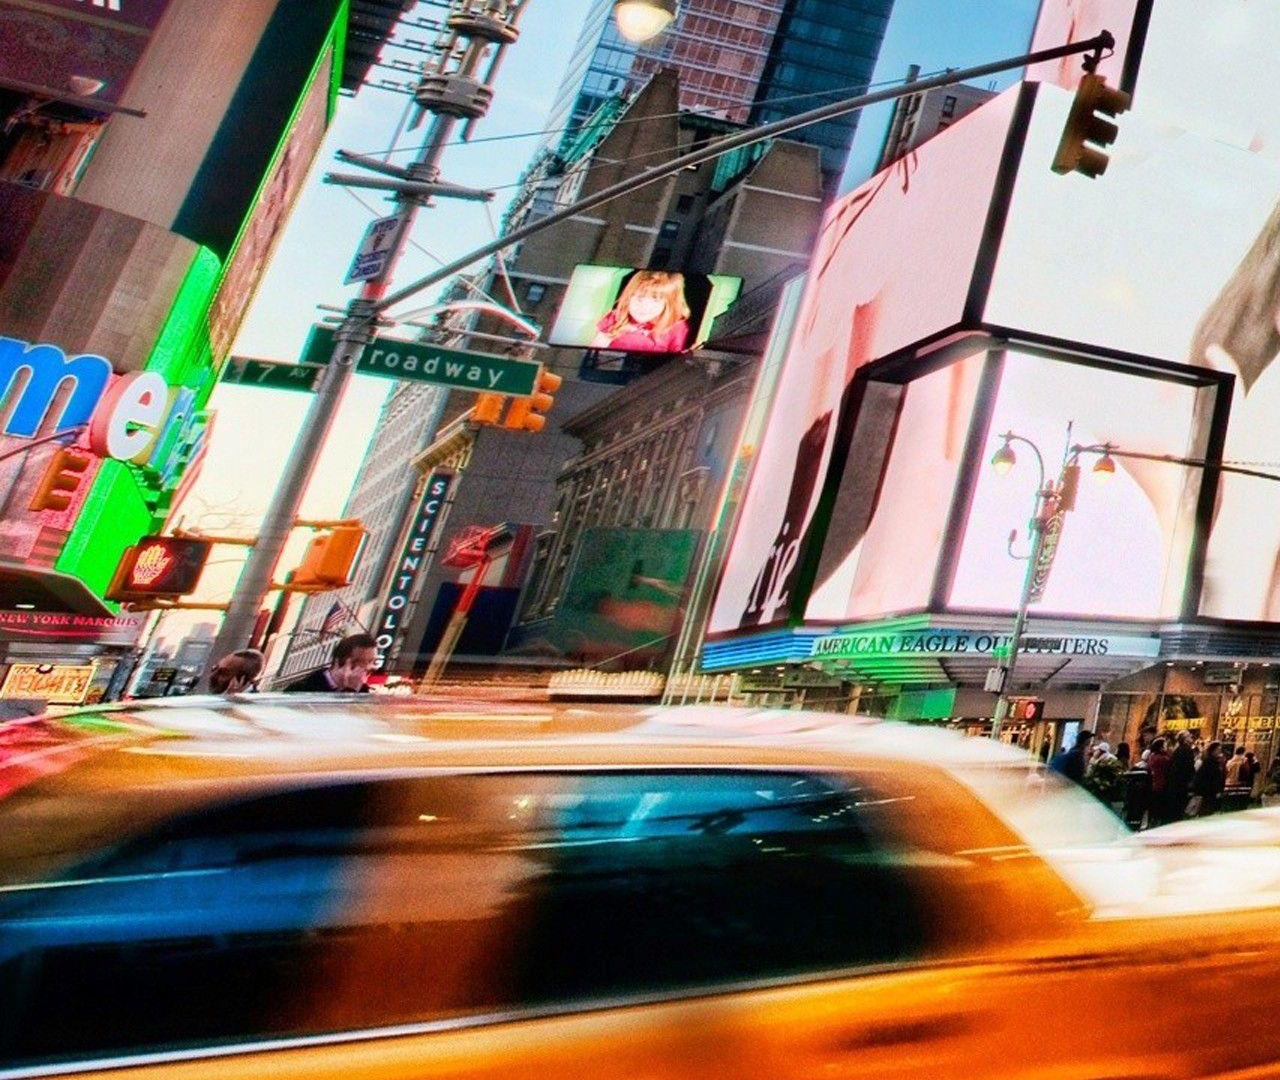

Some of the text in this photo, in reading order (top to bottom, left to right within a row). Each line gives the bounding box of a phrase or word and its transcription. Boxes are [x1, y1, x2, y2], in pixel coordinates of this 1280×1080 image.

[369, 347, 504, 387] roadway
[32, 615, 70, 626] YORK
[815, 635, 1108, 655] AMERICAN EAGLE OUTERS
